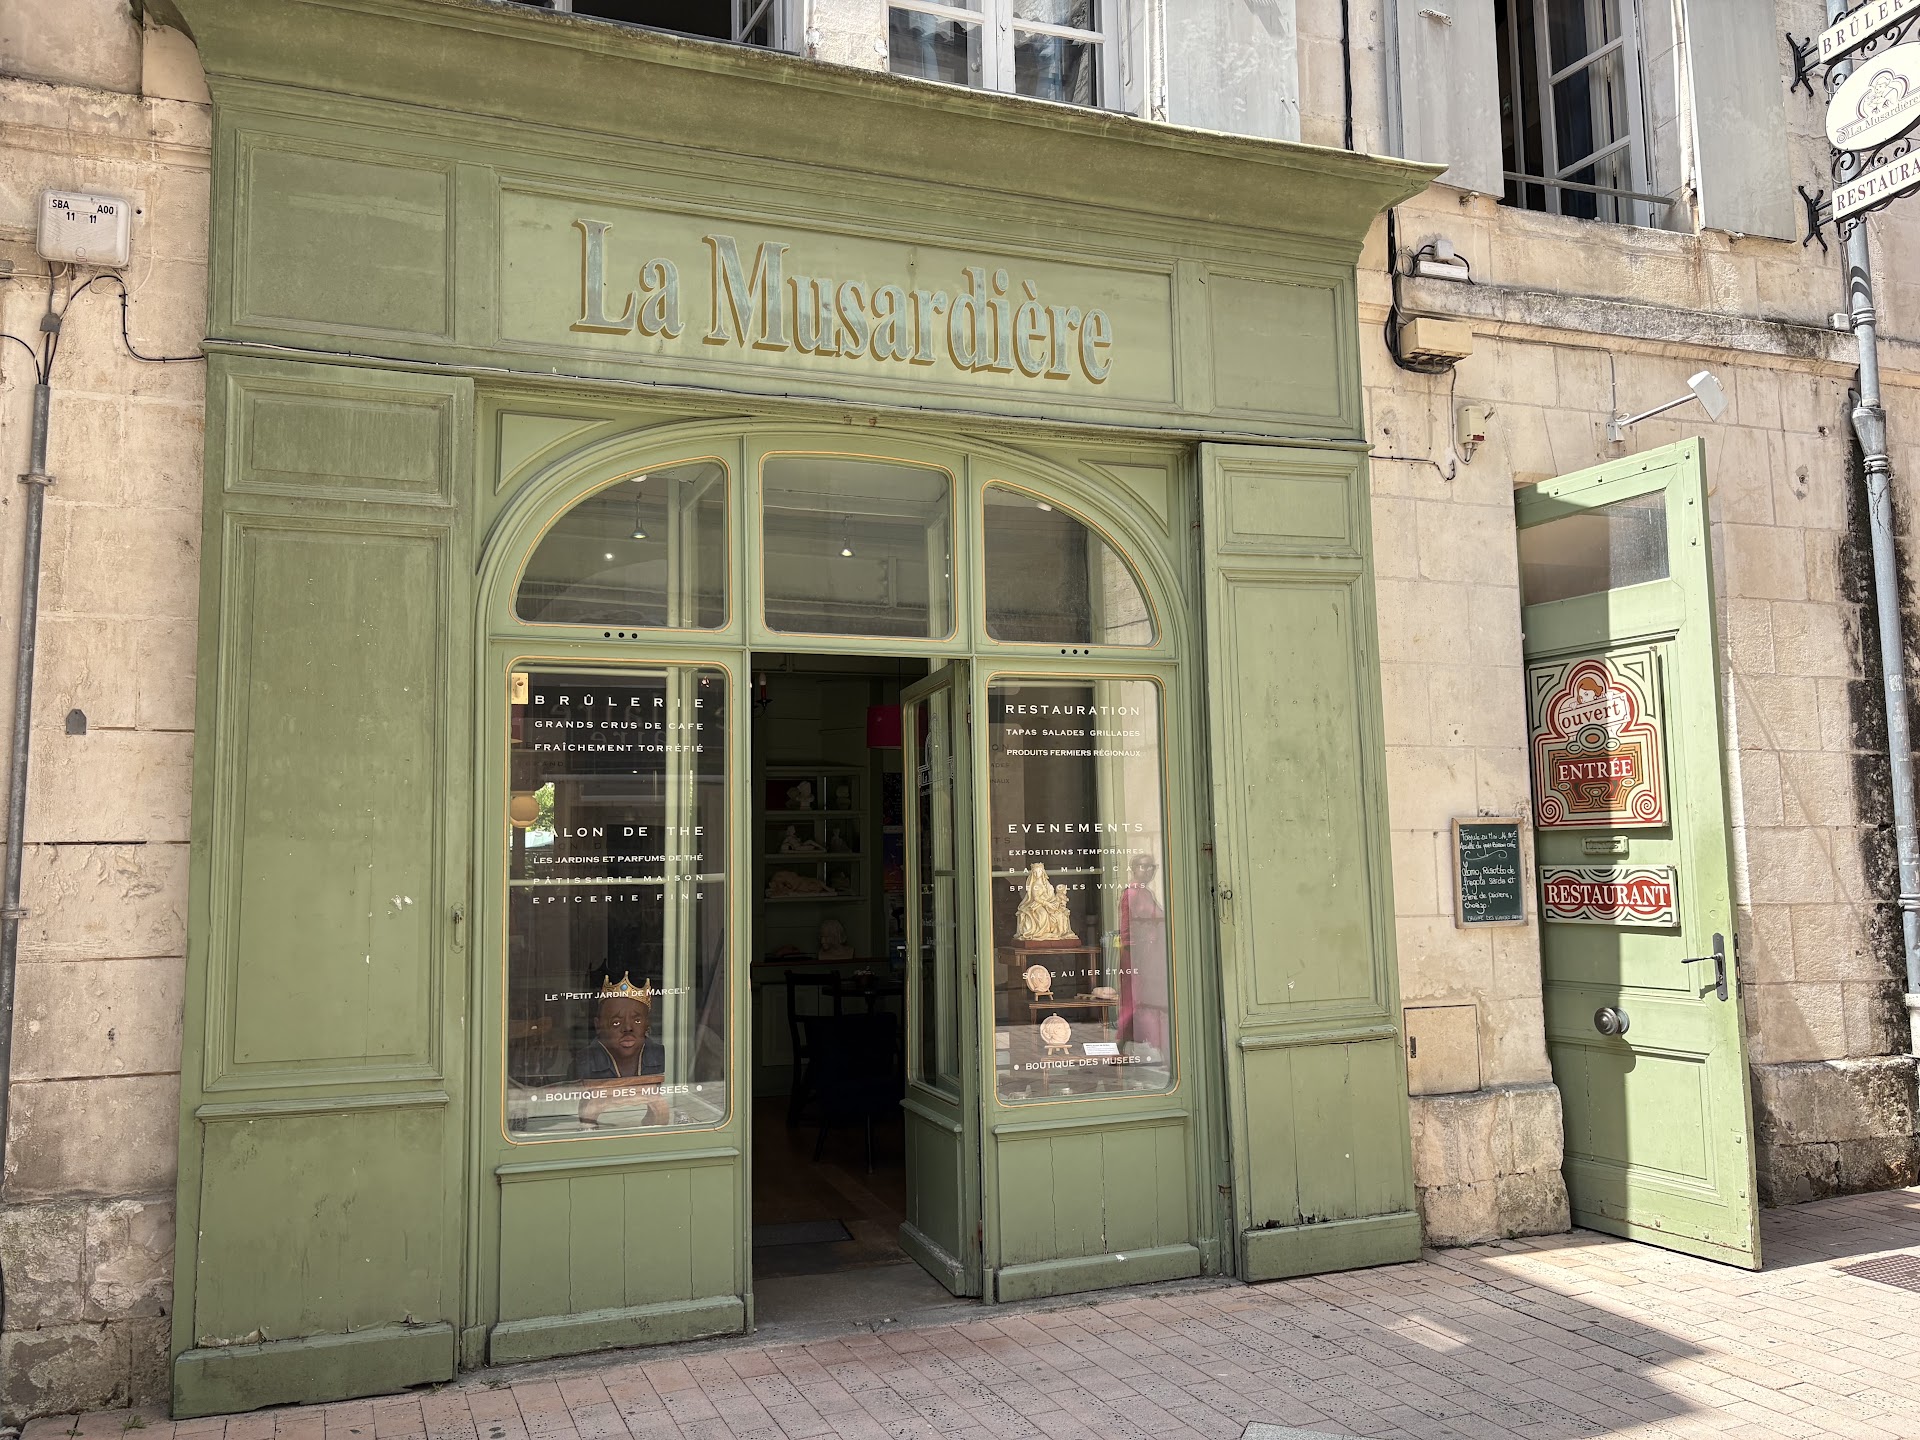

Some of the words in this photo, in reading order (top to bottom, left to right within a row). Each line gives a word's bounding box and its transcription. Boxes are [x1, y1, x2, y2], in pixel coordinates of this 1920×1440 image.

[1823, 0, 1912, 54] BRÛLER
[52, 199, 70, 210] SBA
[97, 205, 114, 215] A00
[66, 211, 75, 221] 11
[89, 214, 97, 224] 11
[570, 217, 686, 339] La
[701, 233, 1114, 385] Musardière
[534, 693, 704, 709] BRÛLERIE
[1005, 704, 1140, 716] RESTAURATION
[1561, 700, 1621, 729] ouvert
[534, 720, 594, 729] GRANDS
[601, 721, 638, 730] CRUS
[644, 721, 662, 730] DE
[668, 722, 704, 731] CAFE
[1006, 728, 1037, 736] TAPAS
[1042, 729, 1085, 737] SALADES
[1089, 729, 1141, 737] GRILLADES
[534, 742, 633, 752] FRAÎCHEMENT
[638, 743, 704, 753] TORRÉFIÉ
[1050, 749, 1091, 757] FERMIERS
[1093, 748, 1141, 757] RÉGIONAUX
[1559, 757, 1632, 781] ENTRÉE
[534, 827, 604, 838] SALON
[623, 827, 649, 837] DE
[667, 826, 704, 836] THE
[1008, 823, 1143, 834] EVENEMENTS
[1008, 848, 1073, 856] EXPOSITIONS
[533, 855, 552, 864] LES
[555, 855, 600, 864] JARDINS
[602, 855, 616, 863] ET
[617, 854, 666, 862] PARFUMS
[668, 854, 682, 862] DE
[684, 853, 704, 861] THÉ
[533, 875, 633, 885] PÂTISSERIE
[643, 874, 704, 883] MAISON
[1009, 883, 1086, 892] SPECACLES
[1097, 882, 1146, 890] VIVANTS
[533, 894, 639, 904] EPICERIE
[656, 893, 704, 901] FINE
[1547, 884, 1668, 907] RESTAURANT
[1025, 1060, 1075, 1071] BOUTIQUE
[1079, 1058, 1098, 1067] DES
[1102, 1055, 1141, 1065] MUSEES
[545, 1091, 608, 1102] BOUTIQUE
[612, 1088, 636, 1098] DES
[641, 1086, 689, 1097] MUSEES
